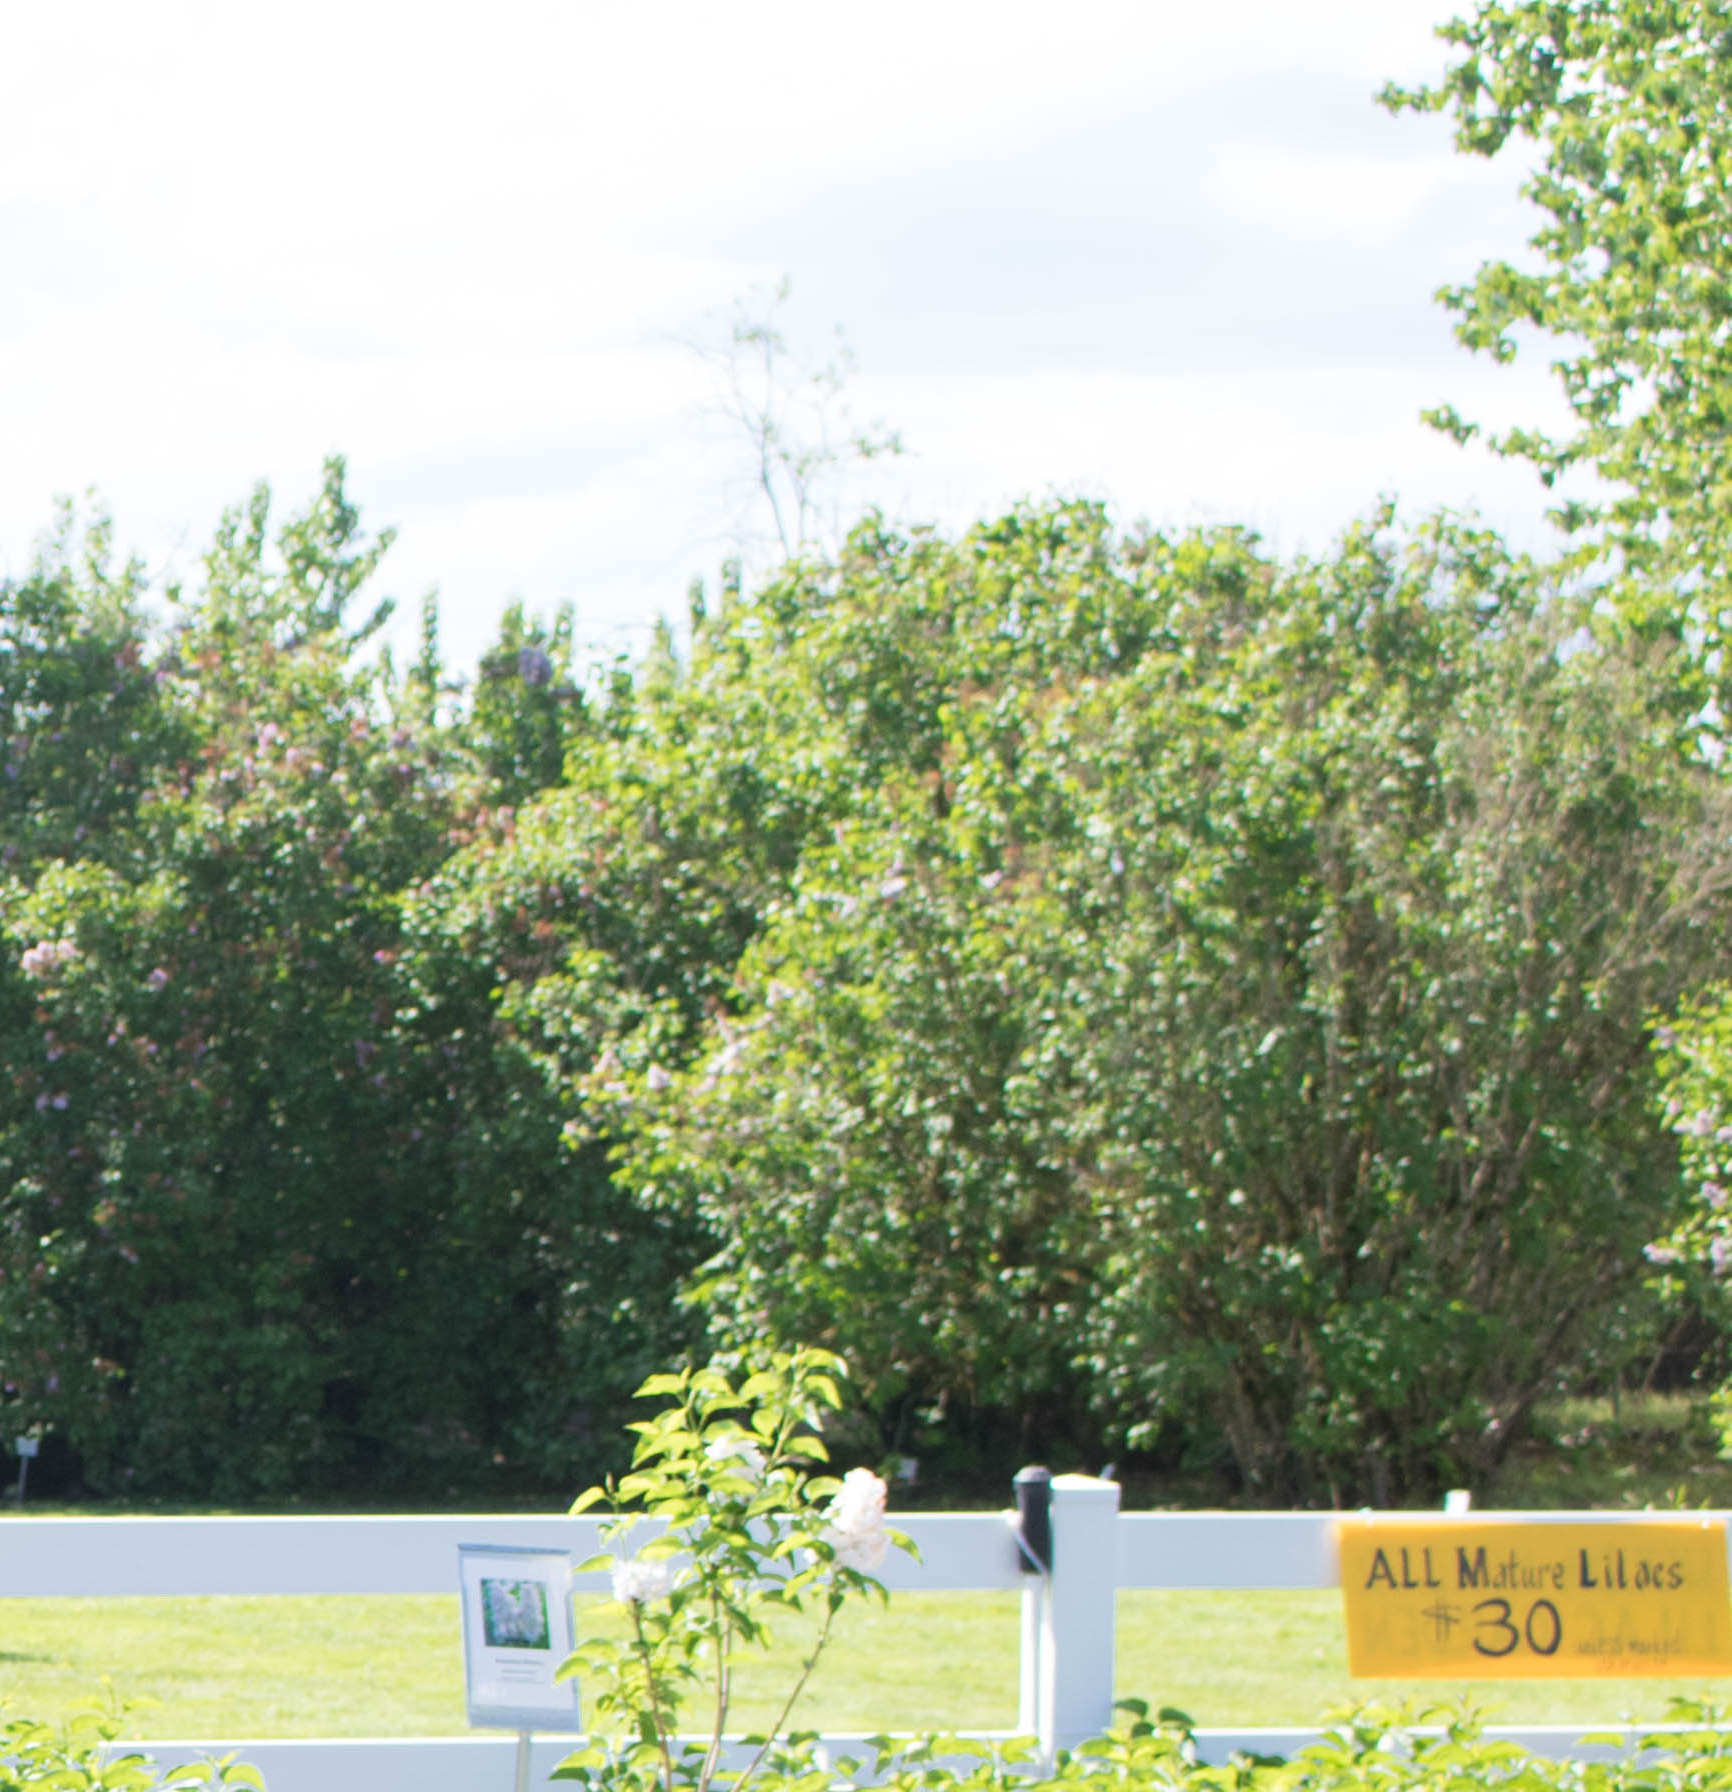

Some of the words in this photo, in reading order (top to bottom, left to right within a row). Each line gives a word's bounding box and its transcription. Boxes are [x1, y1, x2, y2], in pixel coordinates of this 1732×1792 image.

[1365, 1547, 1441, 1590] ALL
[1456, 1546, 1566, 1591] Mature
[1579, 1548, 1685, 1591] Lilacs
[1421, 1597, 1562, 1659] $30
